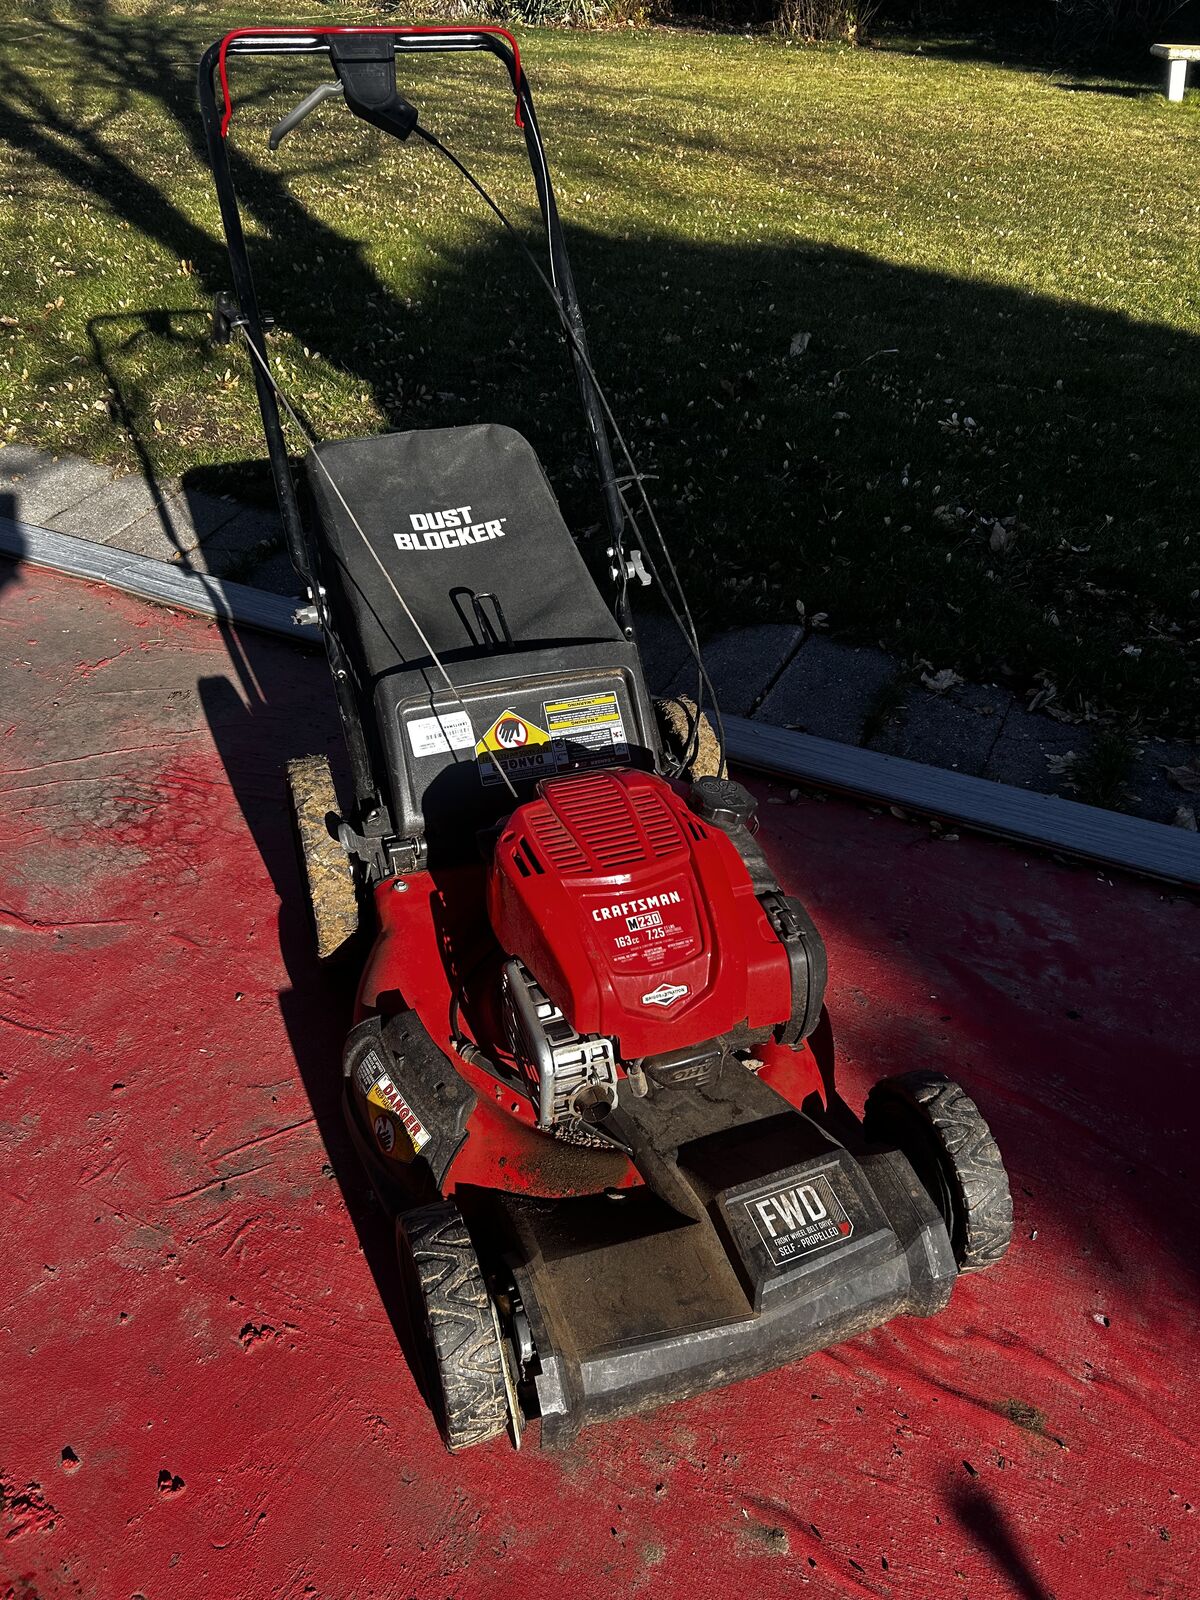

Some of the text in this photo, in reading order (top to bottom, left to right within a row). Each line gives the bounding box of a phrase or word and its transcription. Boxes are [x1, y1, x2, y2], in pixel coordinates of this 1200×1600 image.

[409, 506, 473, 531] DUST
[592, 891, 681, 921] CRAFTSMAN
[627, 912, 662, 932] M230
[646, 927, 666, 940] 7.25
[383, 1083, 422, 1137] DANGER
[756, 1185, 827, 1238] FWD
[774, 1218, 834, 1246] FRONT WHEEL BELT DRIVE
[779, 1243, 797, 1256] SELF
[800, 1226, 839, 1248] PROPELLED
